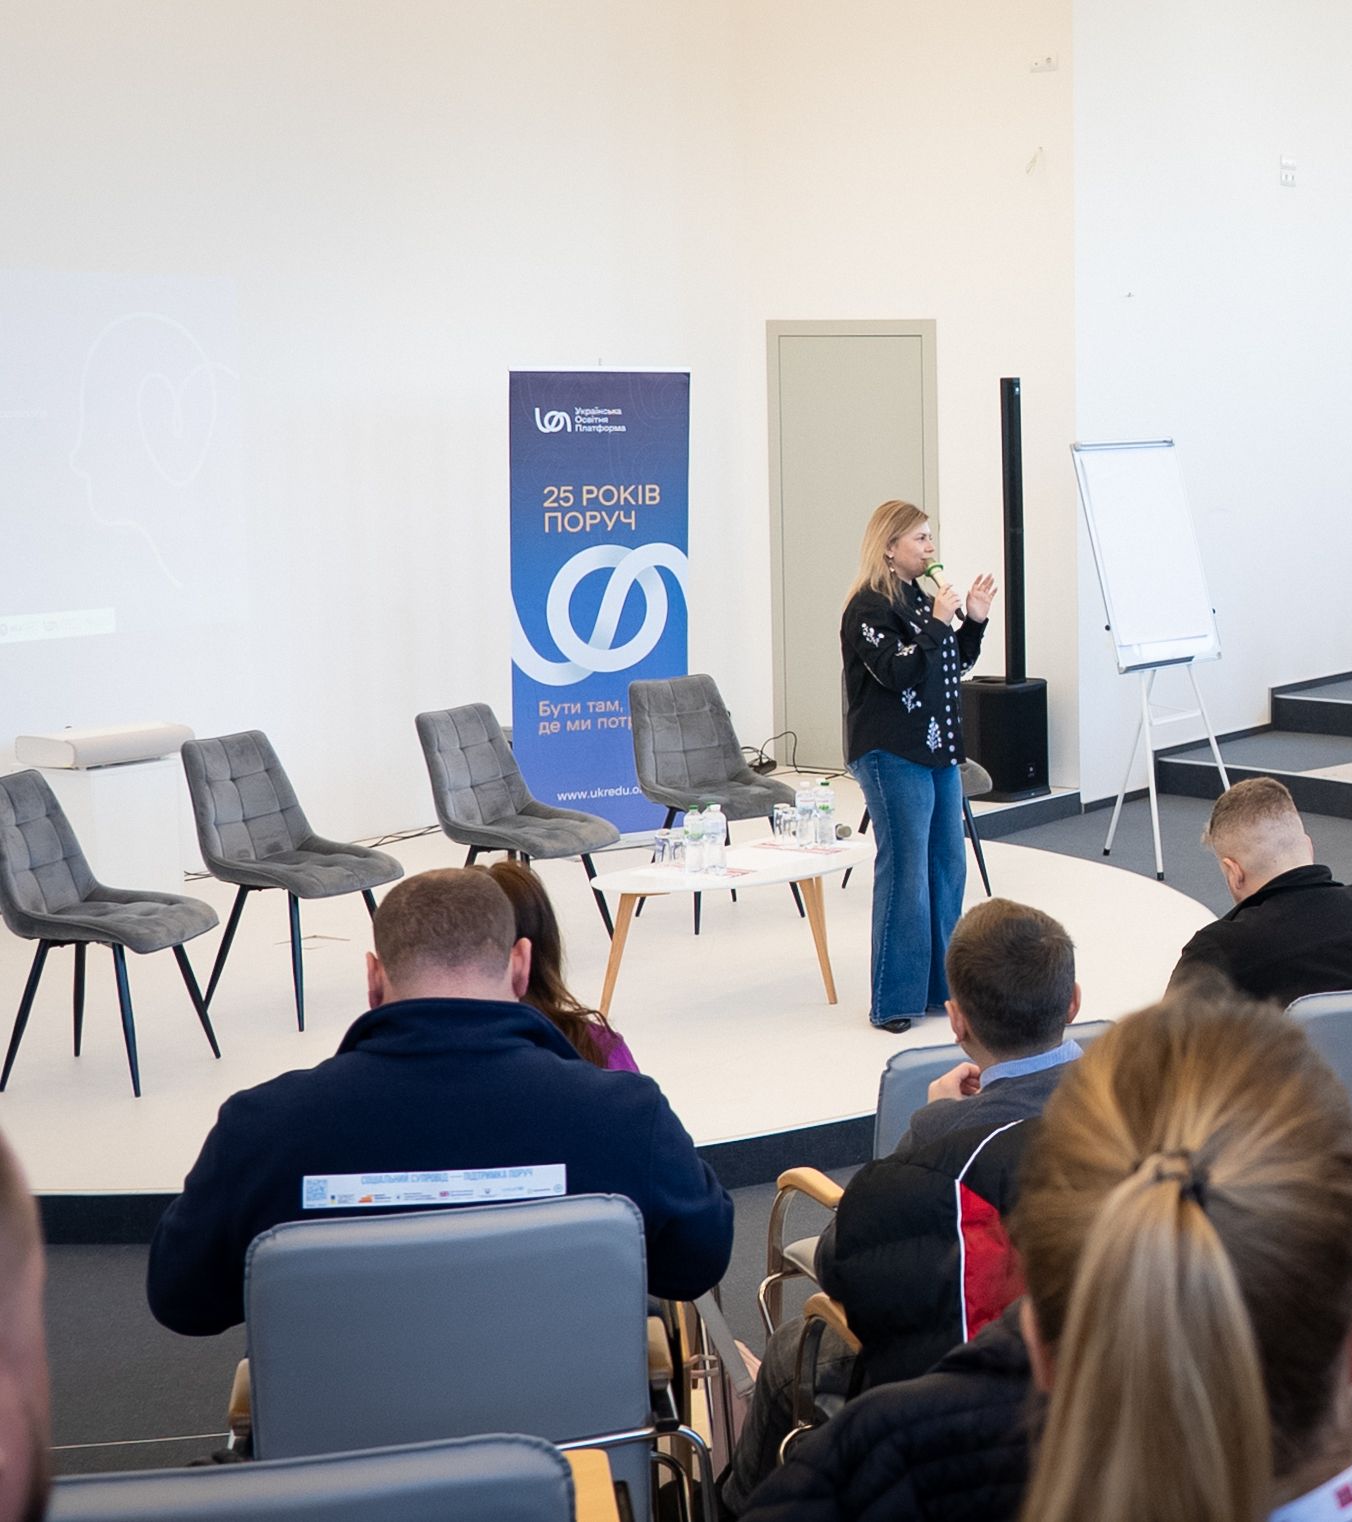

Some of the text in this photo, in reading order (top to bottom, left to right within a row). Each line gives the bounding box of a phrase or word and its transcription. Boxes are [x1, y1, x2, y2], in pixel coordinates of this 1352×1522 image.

[574, 406, 622, 416] Українська
[574, 415, 609, 424] Освітня
[575, 424, 627, 434] Платформа
[543, 484, 661, 508] 25 РОКІВ
[544, 510, 636, 533] ПОРУЧ
[539, 700, 624, 718] Бути там,
[538, 720, 561, 736] де
[566, 719, 592, 731] ми
